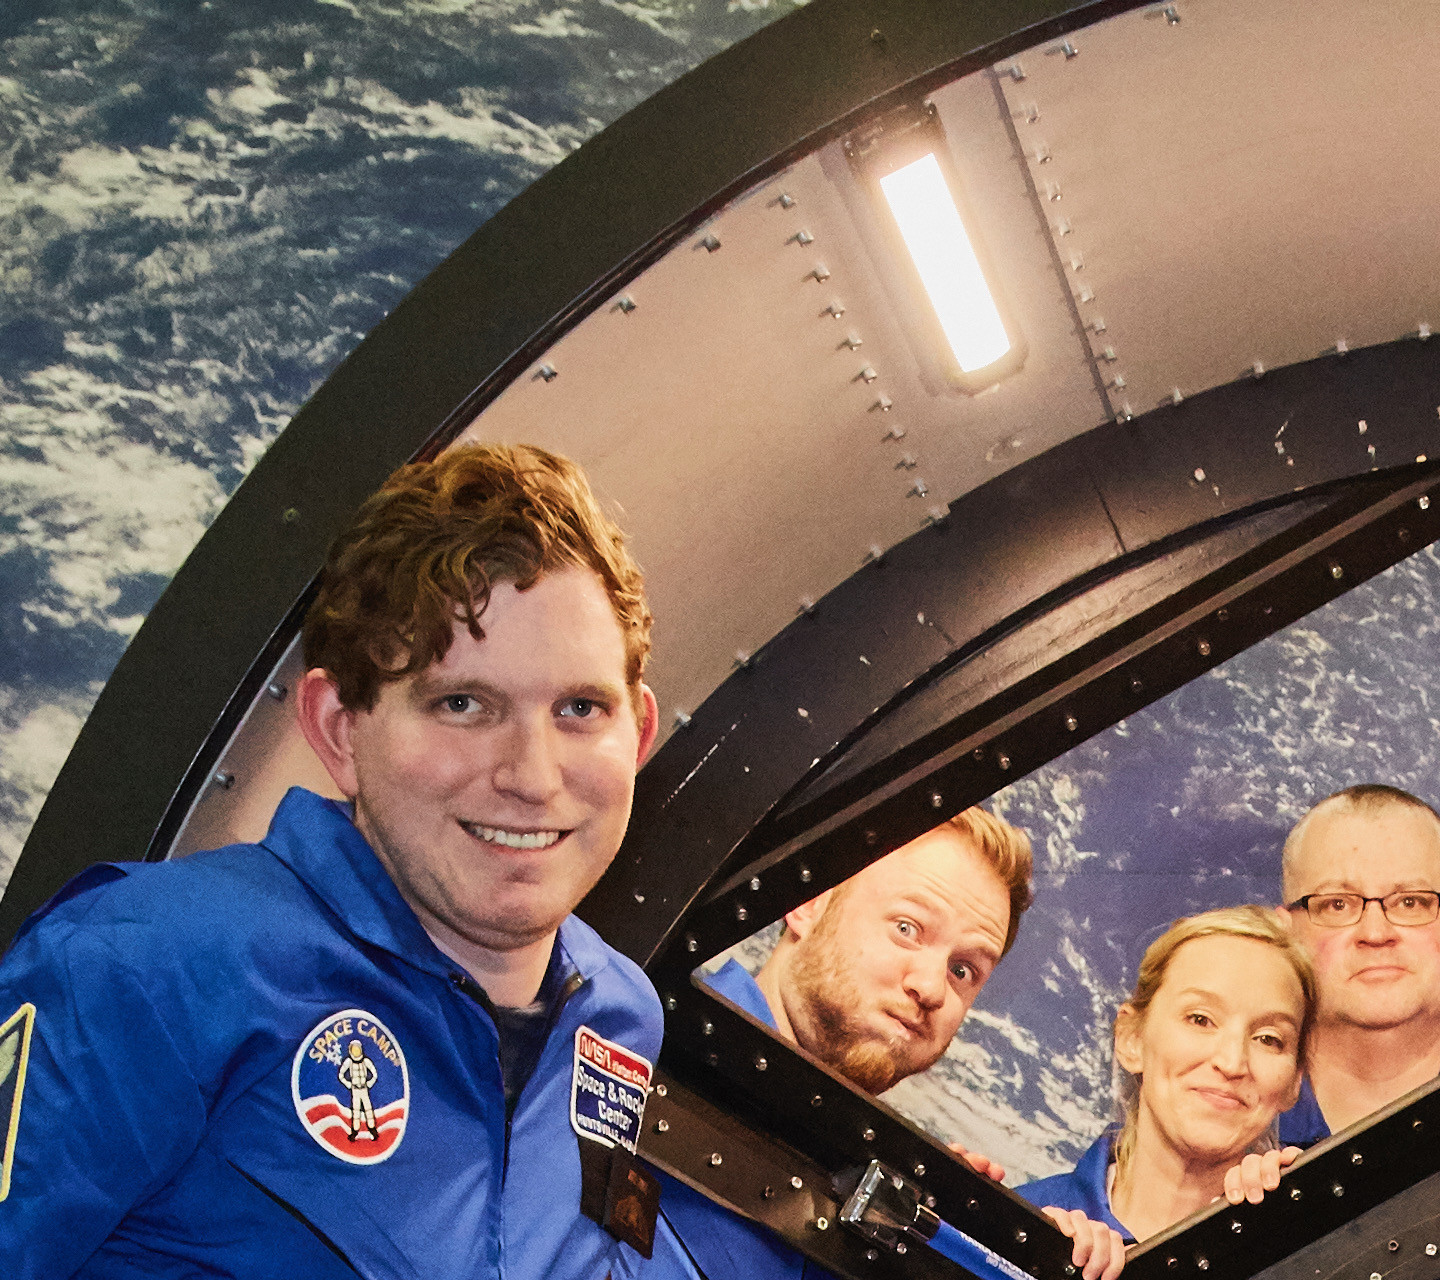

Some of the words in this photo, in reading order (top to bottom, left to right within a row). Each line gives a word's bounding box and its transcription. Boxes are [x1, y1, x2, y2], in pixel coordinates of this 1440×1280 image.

[309, 1019, 353, 1064] SPACE
[357, 1020, 397, 1063] CAMP
[580, 1035, 612, 1070] NASA
[578, 1065, 605, 1099] Space
[598, 1100, 632, 1132] Center
